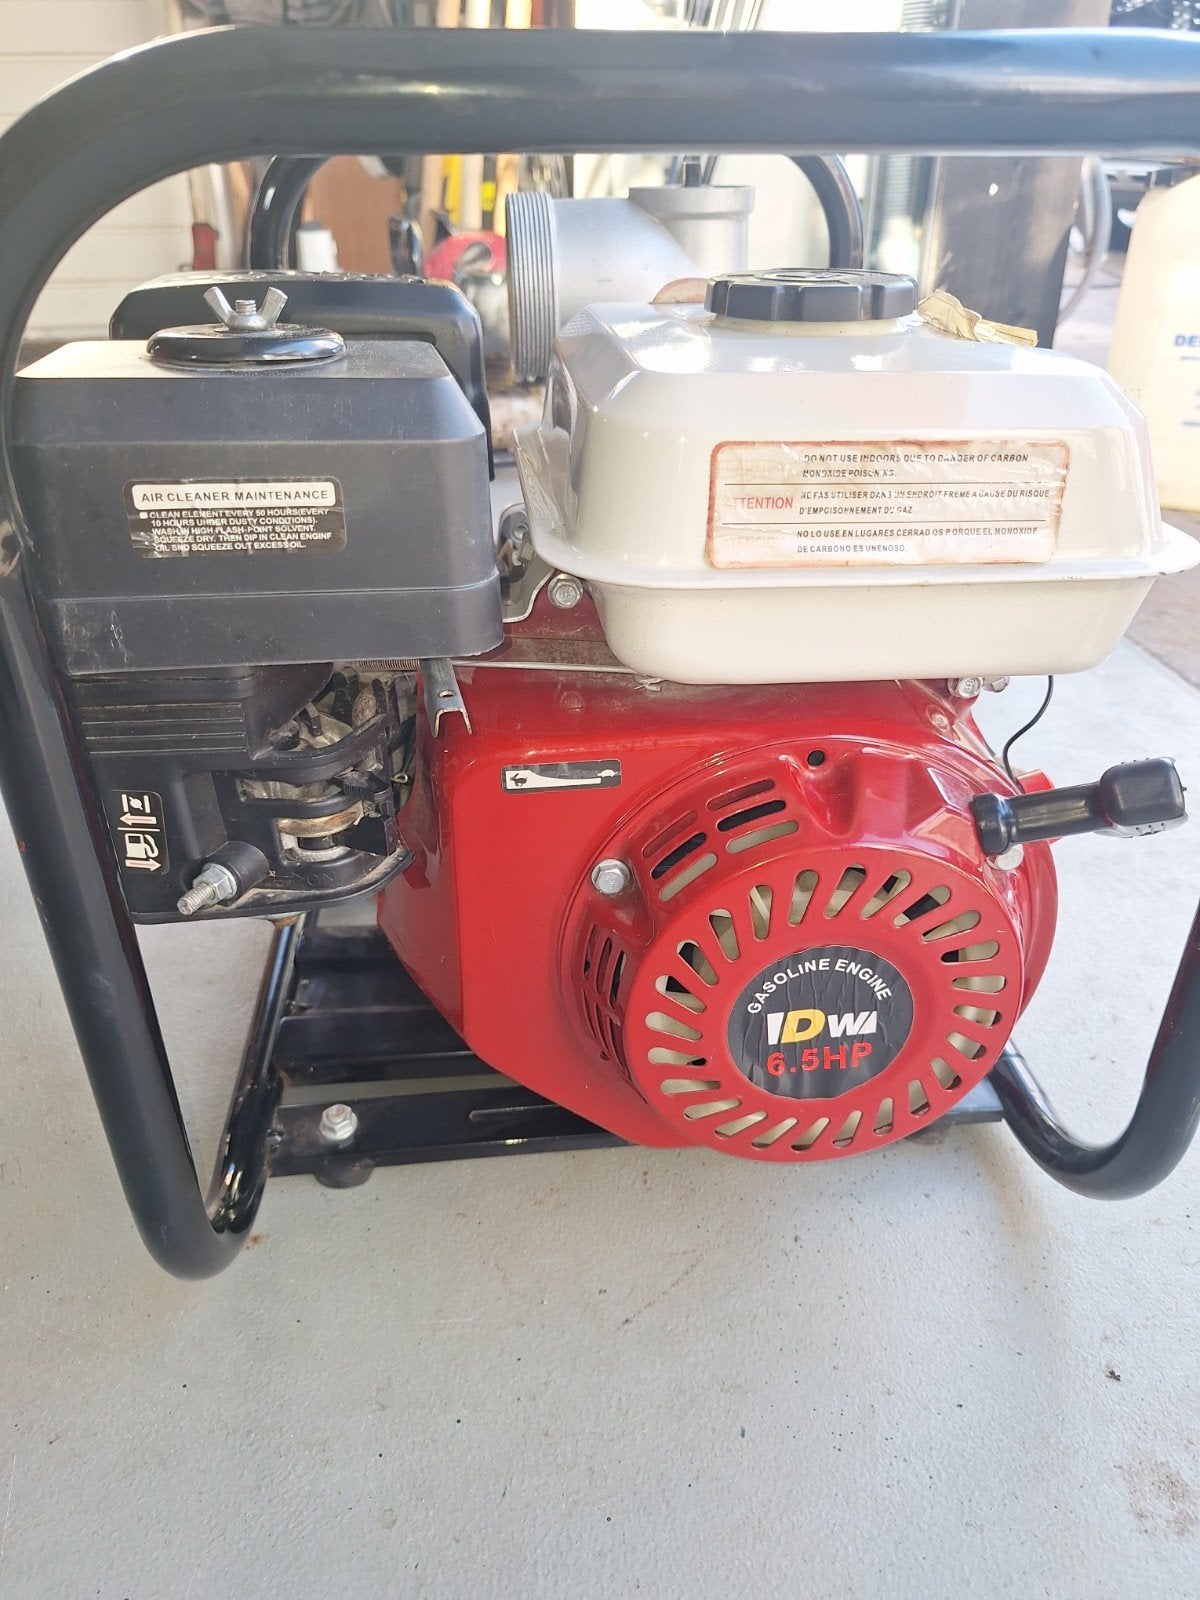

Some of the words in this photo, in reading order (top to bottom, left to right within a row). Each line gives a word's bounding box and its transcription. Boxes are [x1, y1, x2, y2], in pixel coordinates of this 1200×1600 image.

[1174, 336, 1200, 347] DE
[840, 454, 858, 462] USE
[860, 454, 901, 462] INDOORS
[904, 454, 922, 462] DUE
[924, 454, 936, 462] TO
[977, 454, 988, 462] OF
[990, 454, 1028, 462] CARBON
[802, 470, 846, 478] MONOXIDE
[142, 493, 163, 502] AIR
[167, 491, 230, 502] CLEANER
[234, 490, 328, 501] MAINTENANCE
[831, 490, 868, 499] UTILISER
[906, 490, 942, 498] ENDROIT
[944, 490, 971, 498] FREME
[972, 490, 978, 498] A
[1007, 490, 1018, 498] DU
[1020, 490, 1050, 498] RISQUE
[259, 517, 318, 525] CONDITIONS).
[215, 526, 273, 534] FLASH-POINT
[824, 530, 840, 538] USE
[855, 529, 895, 537] LUGARES
[153, 535, 194, 544] SQUEEZE
[810, 545, 852, 553] CARBONO
[747, 958, 830, 1014] GASOLINE
[834, 958, 892, 1001] ENGINE
[766, 1042, 873, 1076] 6.5HP
